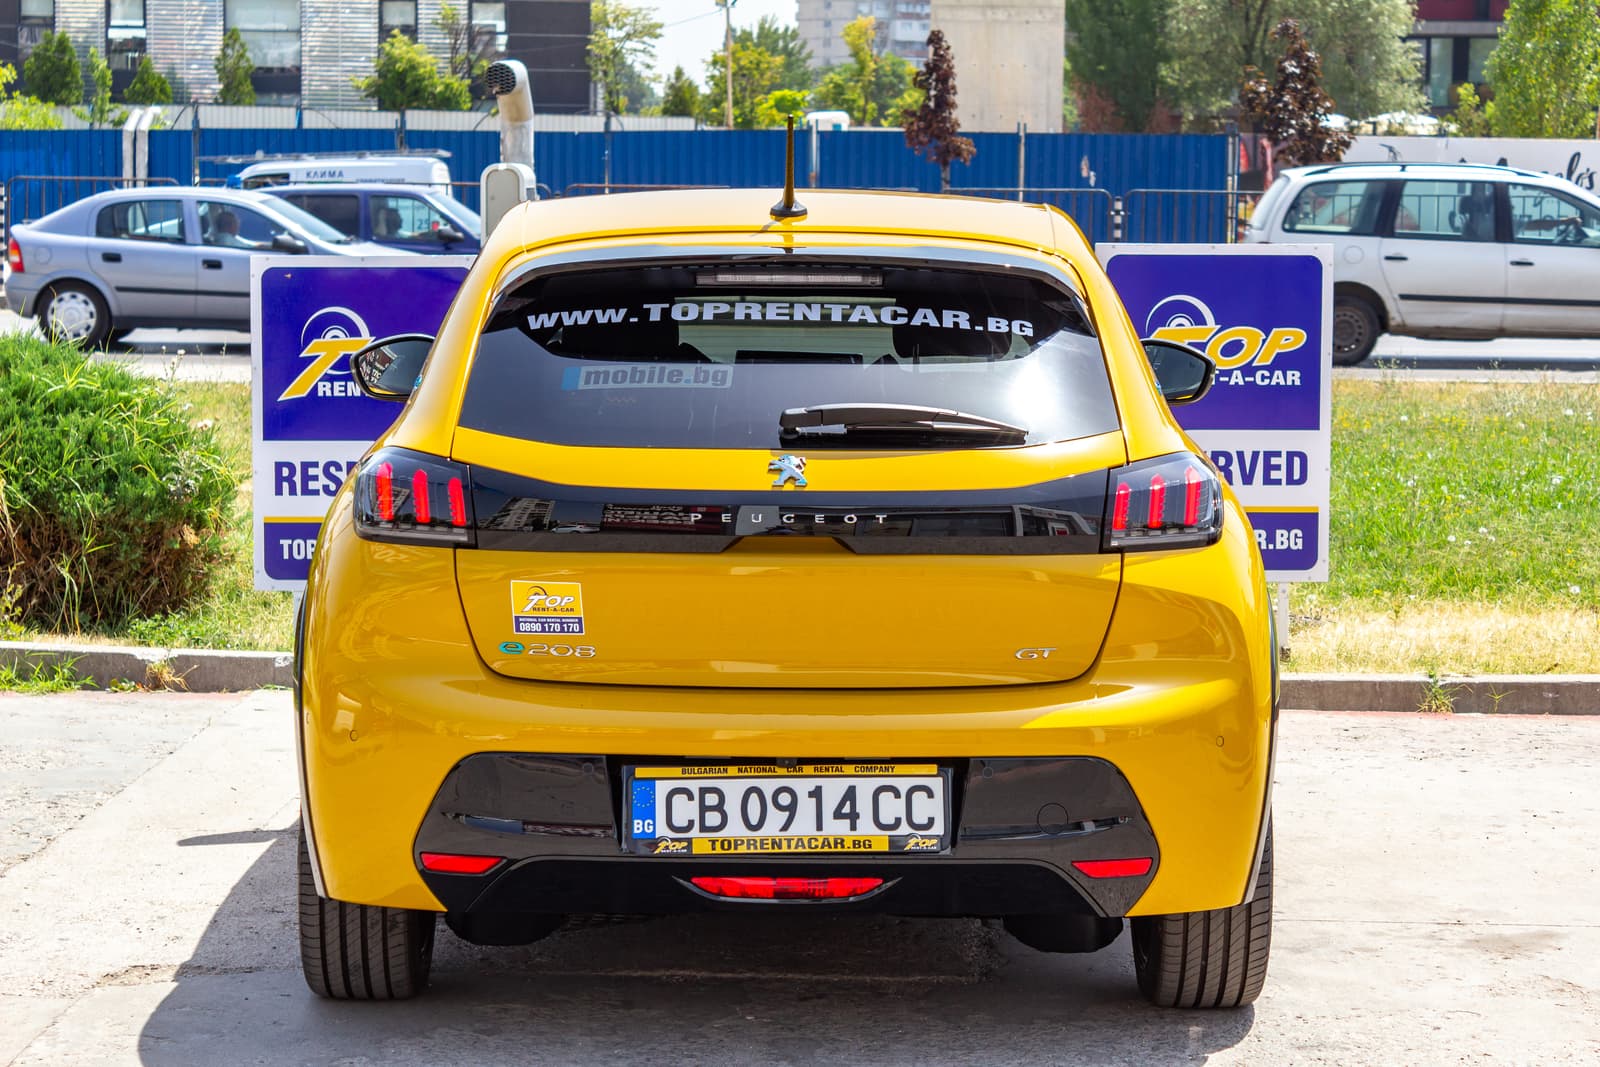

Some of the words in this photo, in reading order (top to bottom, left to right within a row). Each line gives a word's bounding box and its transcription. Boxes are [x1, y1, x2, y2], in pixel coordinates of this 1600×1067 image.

[305, 169, 344, 179] КЛИМА
[526, 302, 1034, 337] www.TOPRENTACAR.BG
[583, 366, 729, 387] mobile.bg
[317, 381, 368, 397] REN
[1210, 450, 1308, 486] RVED
[274, 460, 358, 497] RES
[690, 512, 888, 525] PEUGEOT
[521, 594, 575, 612] TOP
[519, 622, 541, 632] 0890
[544, 623, 561, 632] 170
[563, 623, 580, 633] 170
[1014, 647, 1057, 660] GT
[681, 767, 728, 775] BULGARIAN
[737, 766, 778, 774] NATIONAL
[786, 765, 804, 774] CAR
[813, 765, 845, 773] RENTAL
[854, 765, 896, 773] COMPANY
[664, 786, 729, 834] CB
[740, 784, 860, 832] 0914
[871, 784, 936, 832] CC
[633, 819, 654, 834] BG
[707, 838, 873, 852] TOPRENTACAR.BG
